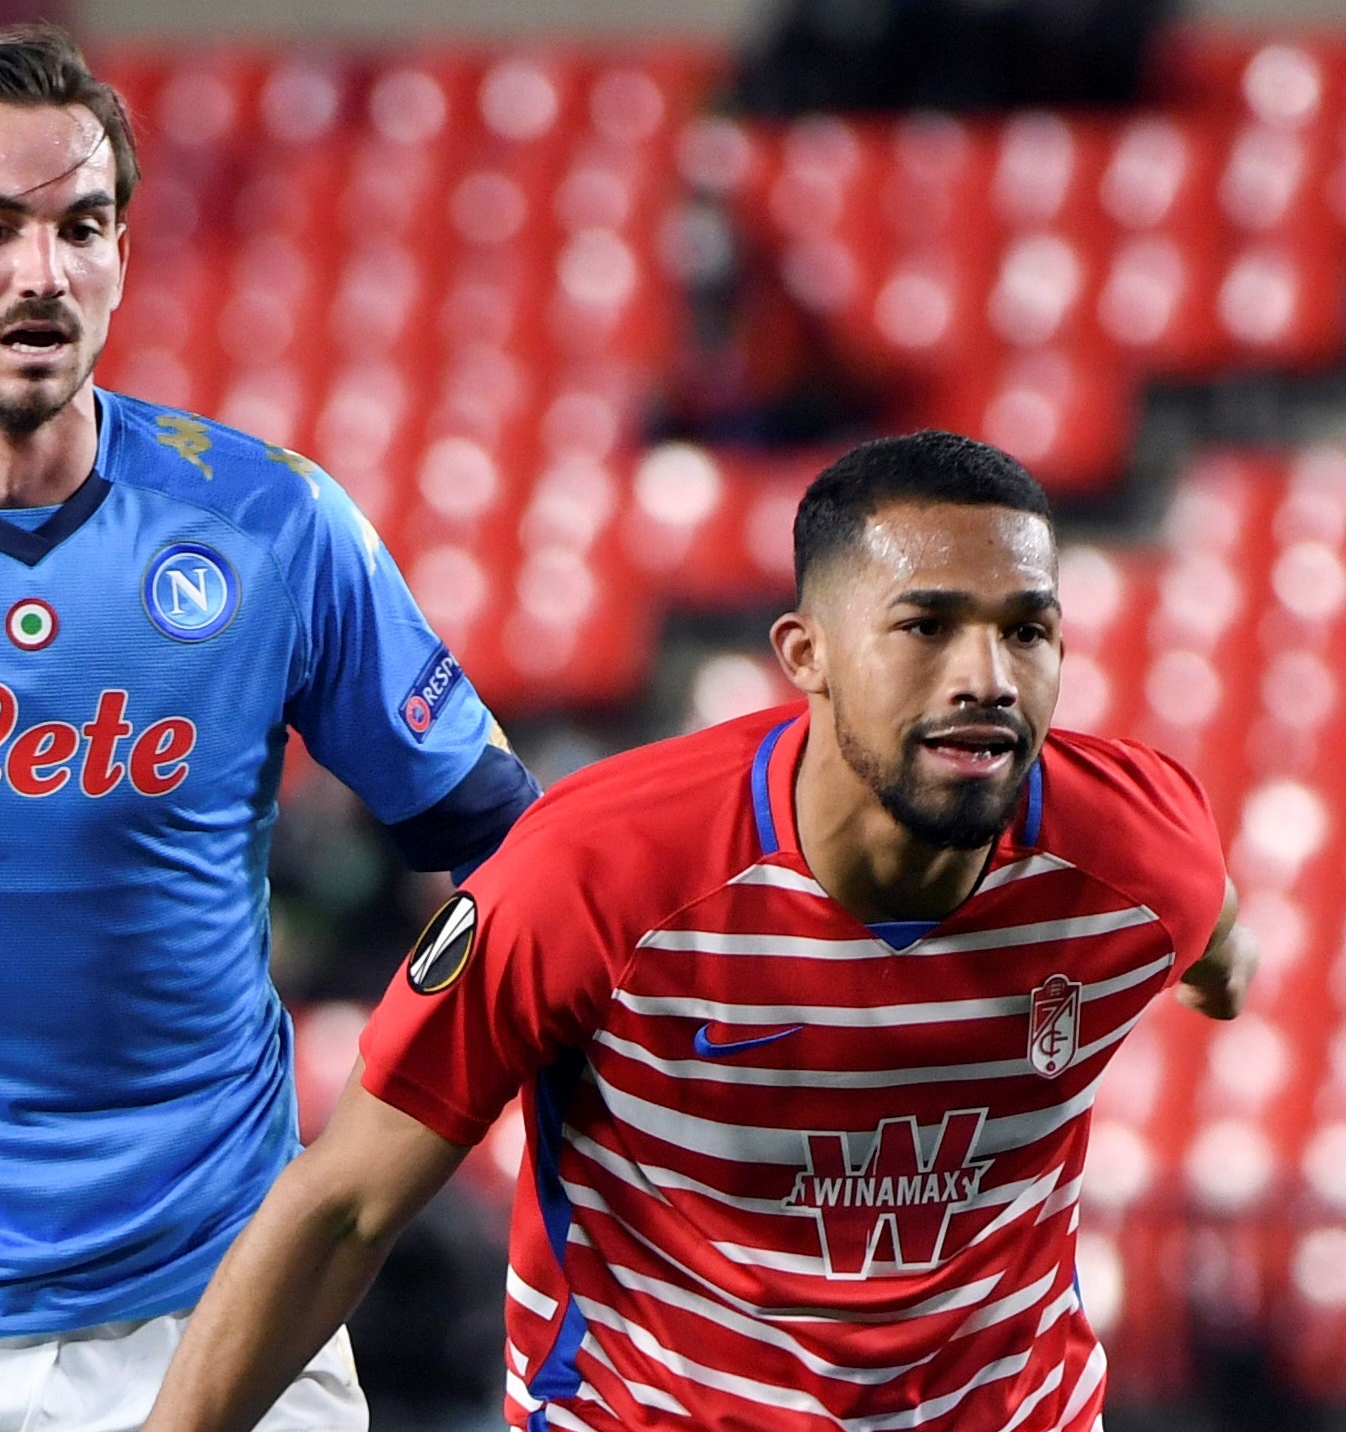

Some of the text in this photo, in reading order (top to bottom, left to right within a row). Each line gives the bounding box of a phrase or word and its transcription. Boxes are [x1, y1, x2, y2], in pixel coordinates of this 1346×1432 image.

[165, 568, 208, 615] N
[422, 652, 459, 706] RESP
[813, 1171, 960, 1208] WINAMAX
